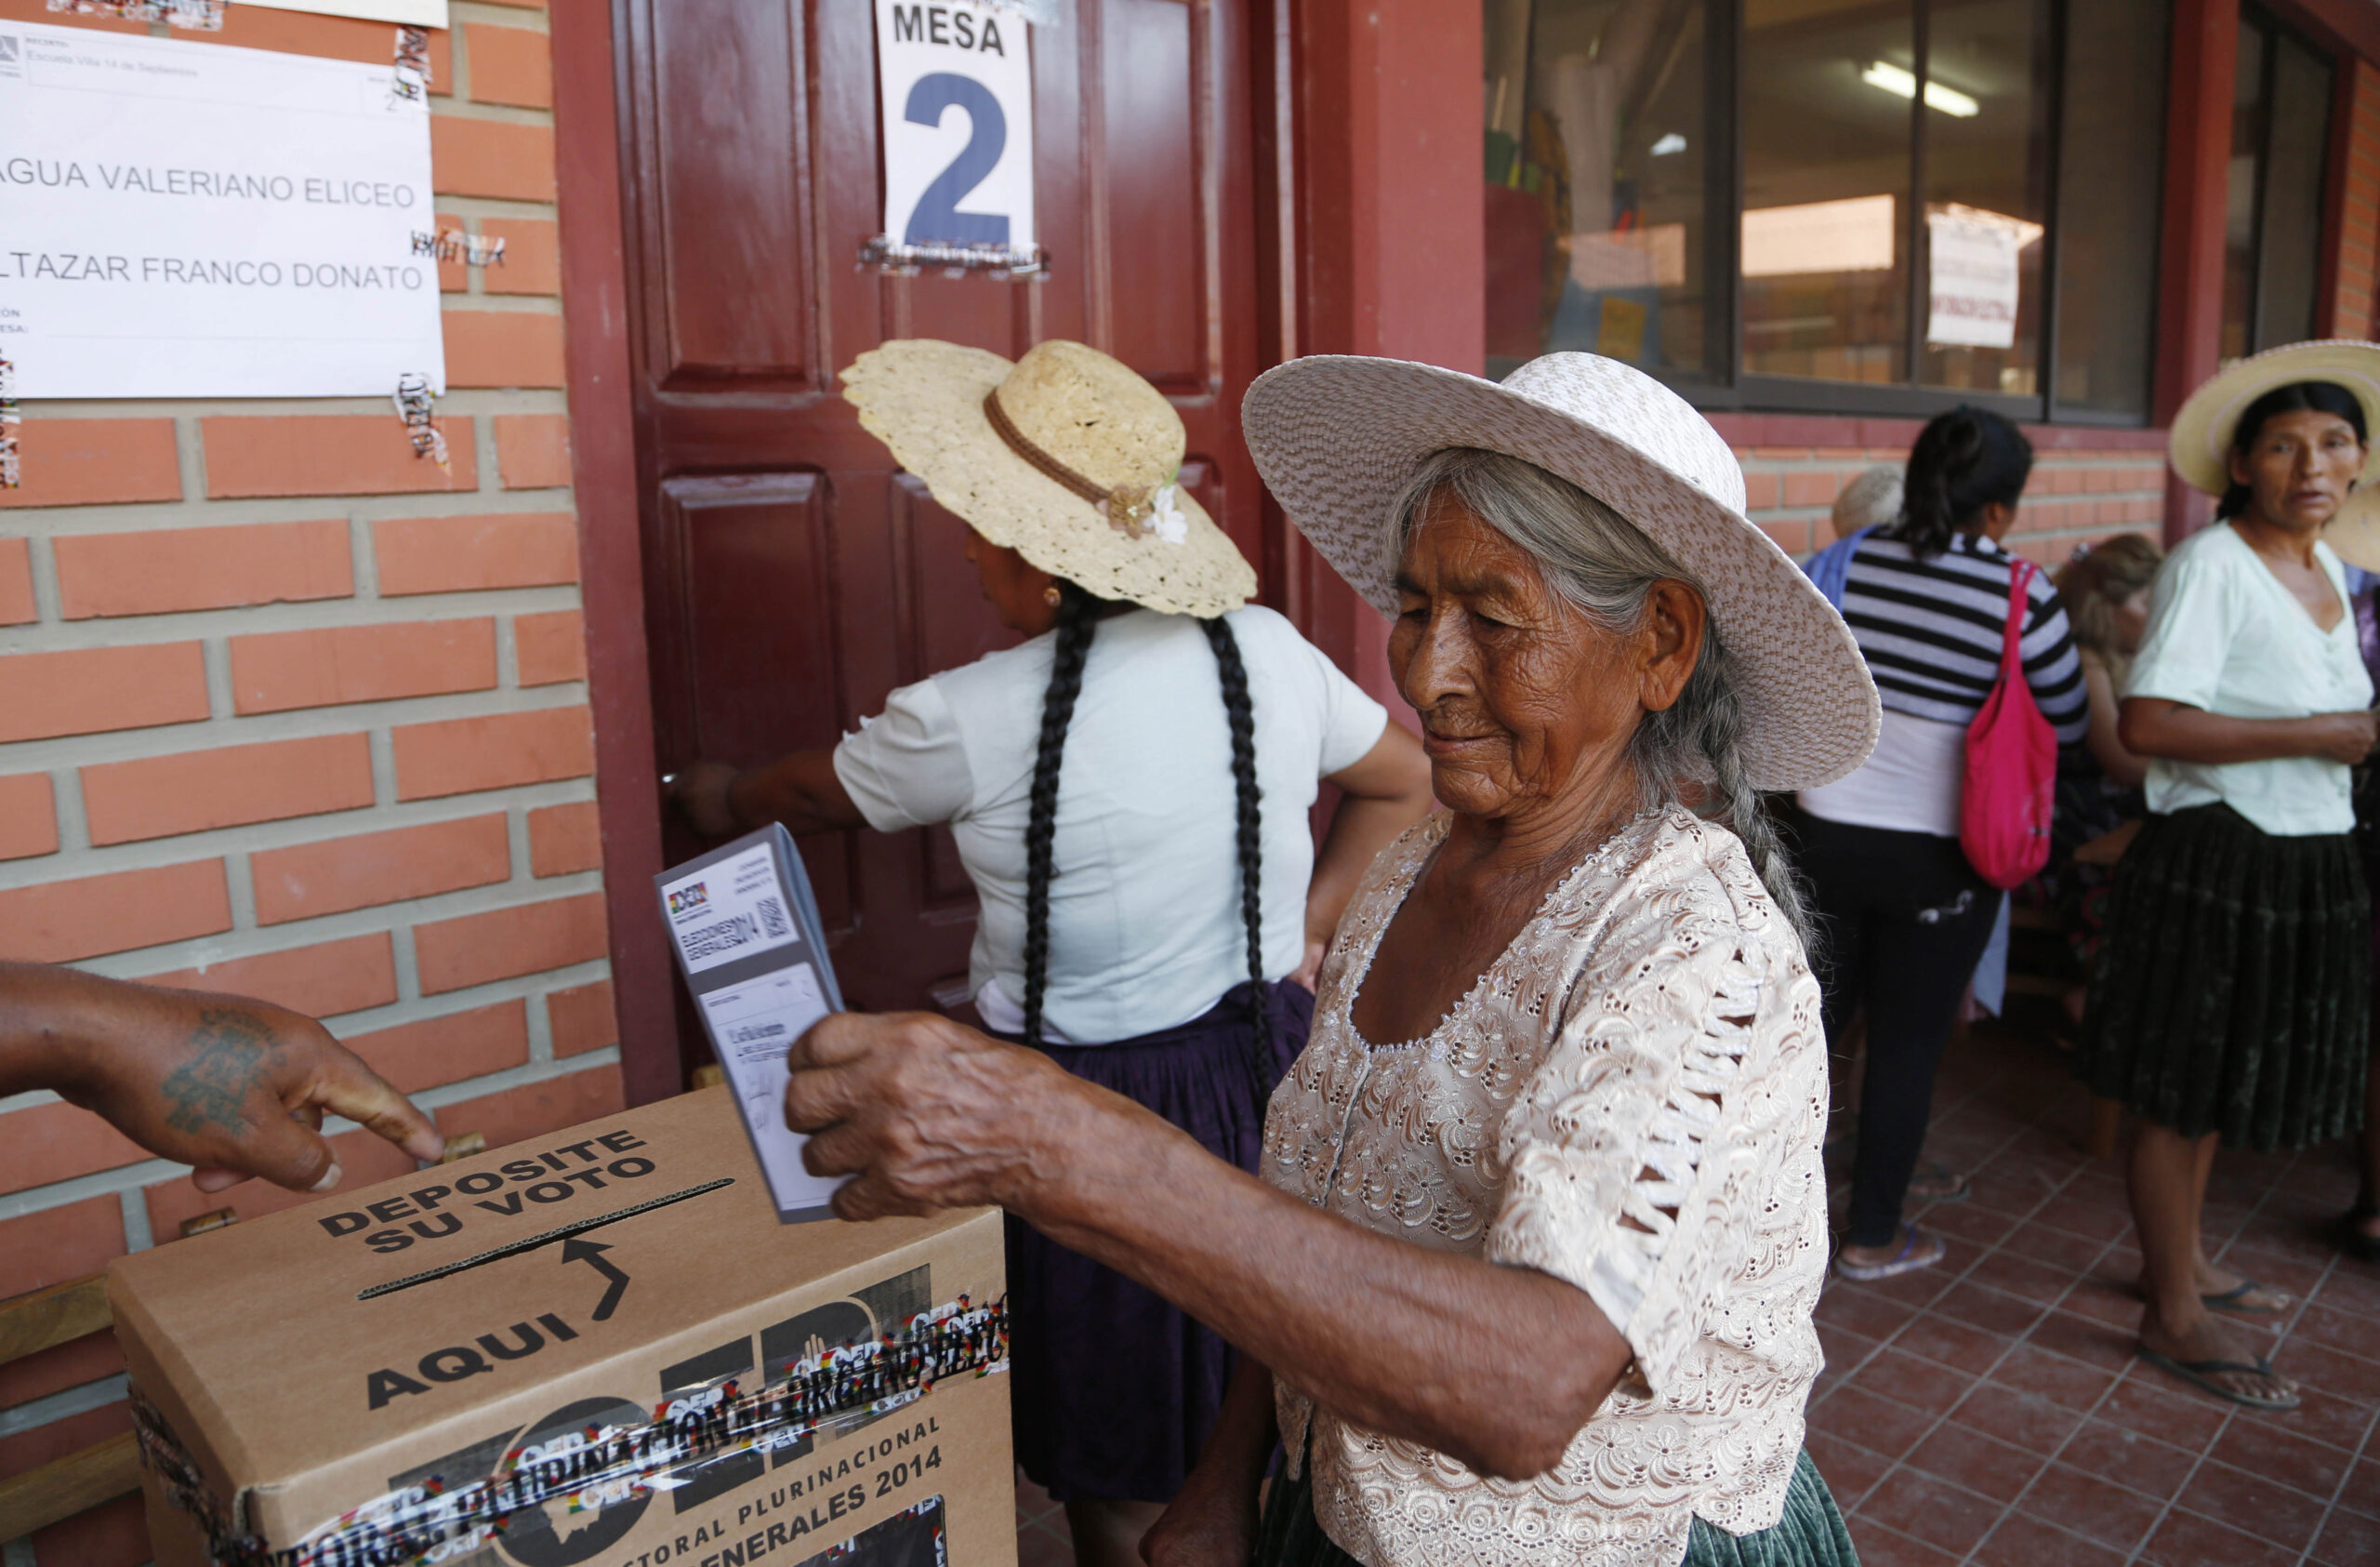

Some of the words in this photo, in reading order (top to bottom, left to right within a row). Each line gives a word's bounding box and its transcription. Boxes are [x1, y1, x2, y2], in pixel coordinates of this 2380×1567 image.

[893, 5, 1005, 57] MESA
[98, 164, 293, 201] VALERIANO
[305, 178, 414, 208] ELICEO
[904, 72, 1010, 252] 2
[142, 258, 282, 286] FRANCO
[293, 263, 422, 290] DONATO
[317, 1129, 648, 1238] DEPOSITE
[364, 1212, 463, 1254] SU
[473, 1157, 655, 1216] VOTO
[366, 1312, 580, 1411] AQUI
[666, 1388, 724, 1425] OEP
[622, 1519, 725, 1567] TORAL
[738, 1416, 941, 1526] PLURINACIONAL
[699, 1483, 866, 1567] ENERALES
[875, 1444, 942, 1499] 2014
